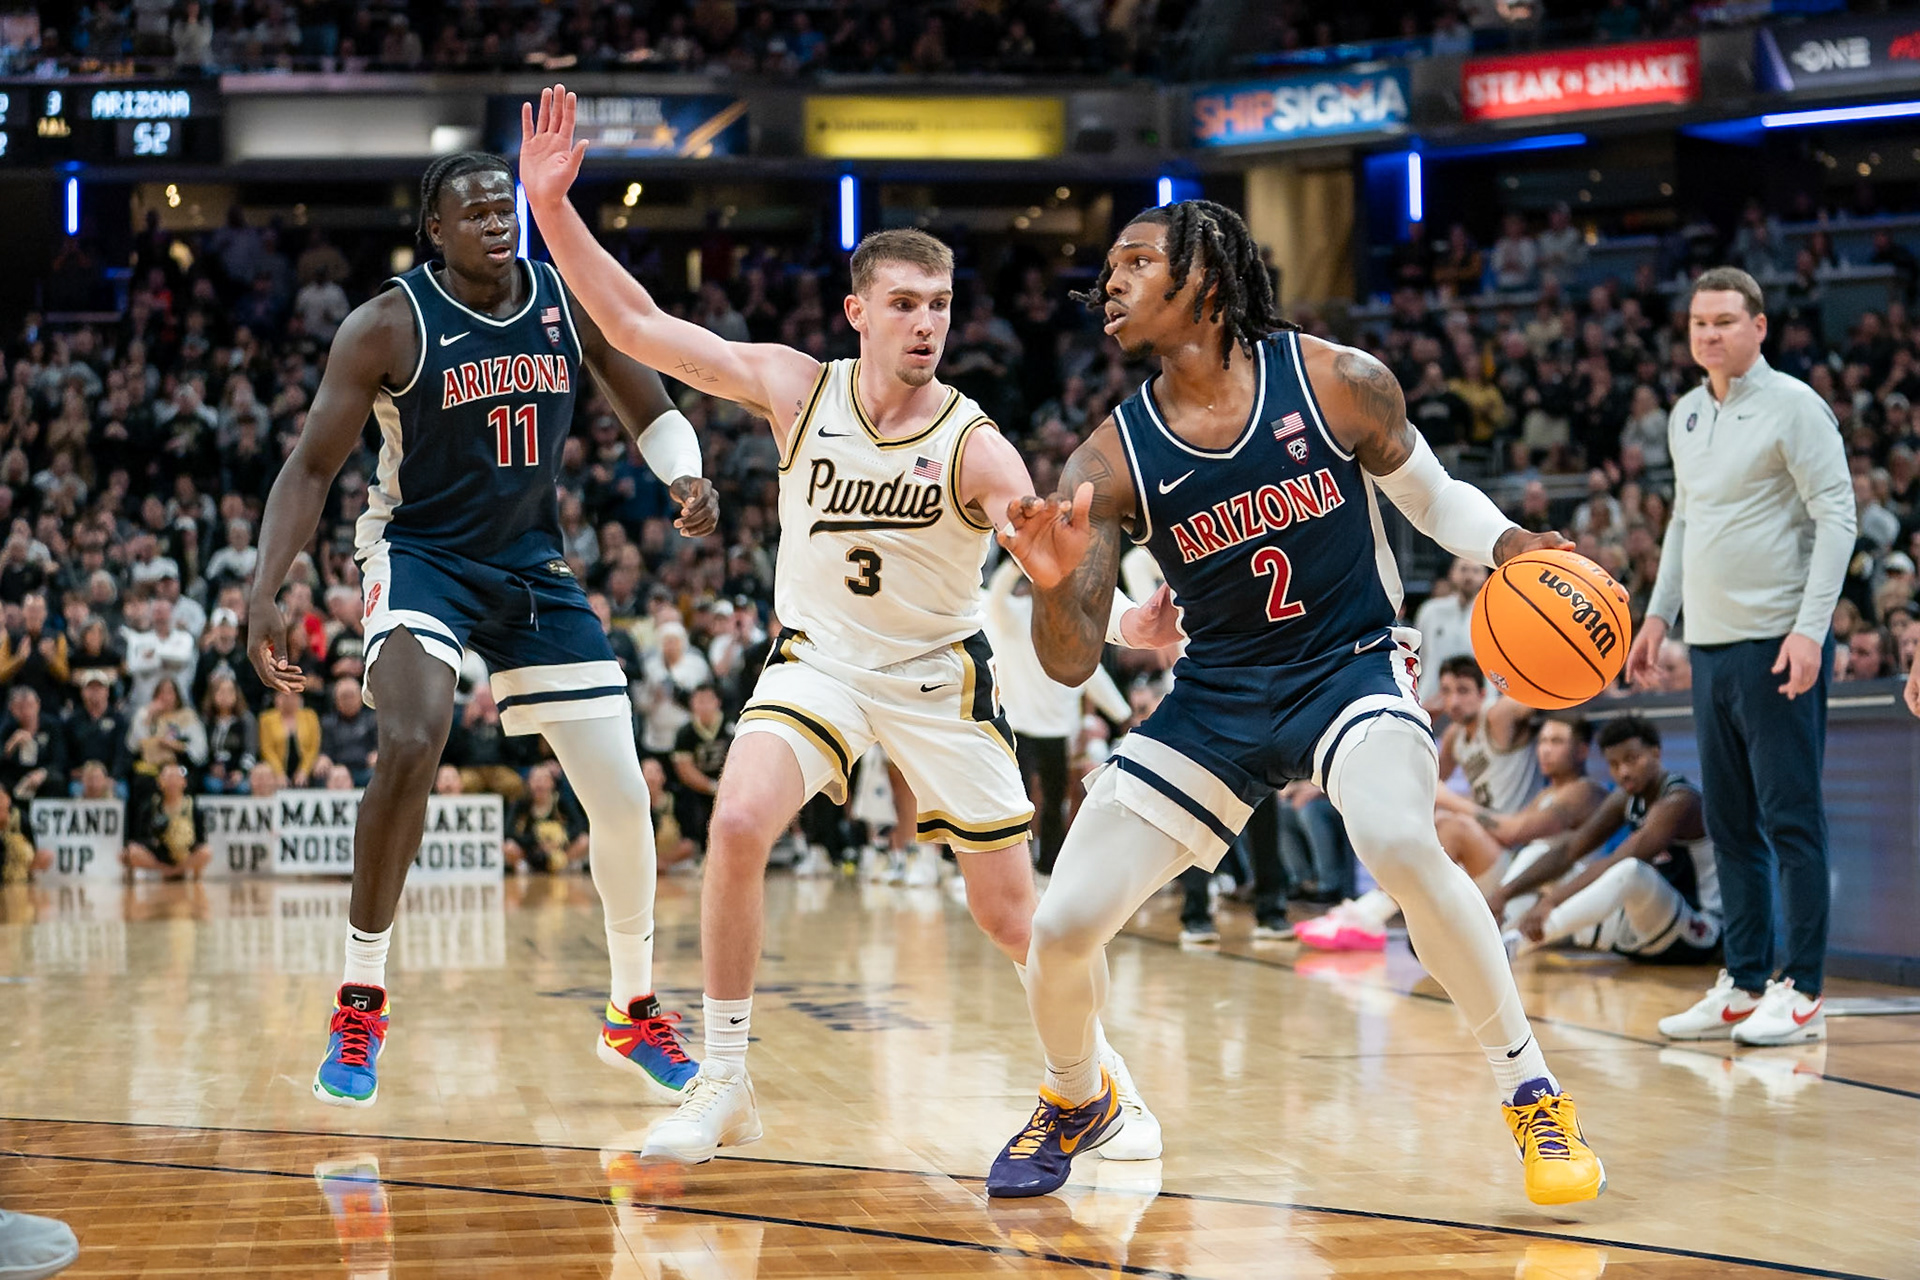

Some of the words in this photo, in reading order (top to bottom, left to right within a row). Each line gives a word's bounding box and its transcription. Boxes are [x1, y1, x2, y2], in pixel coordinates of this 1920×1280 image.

[1467, 67, 1563, 108] STEAK
[1585, 53, 1689, 96] SHAKE
[91, 90, 191, 119] ARIZONA
[133, 122, 171, 156] 52
[442, 353, 570, 410] ARIZONA
[487, 403, 539, 467] 11
[806, 457, 943, 522] Purdue
[1170, 468, 1346, 564] ARIZONA
[844, 545, 882, 597] 3
[1251, 546, 1306, 622] 2
[1538, 568, 1617, 660] Wilson
[35, 807, 119, 836] STAND
[203, 806, 272, 833] STAN
[281, 801, 360, 827] MAK
[423, 806, 497, 833] AKE
[57, 844, 95, 874] UP
[228, 842, 268, 871] UP
[280, 835, 352, 863] NOIS
